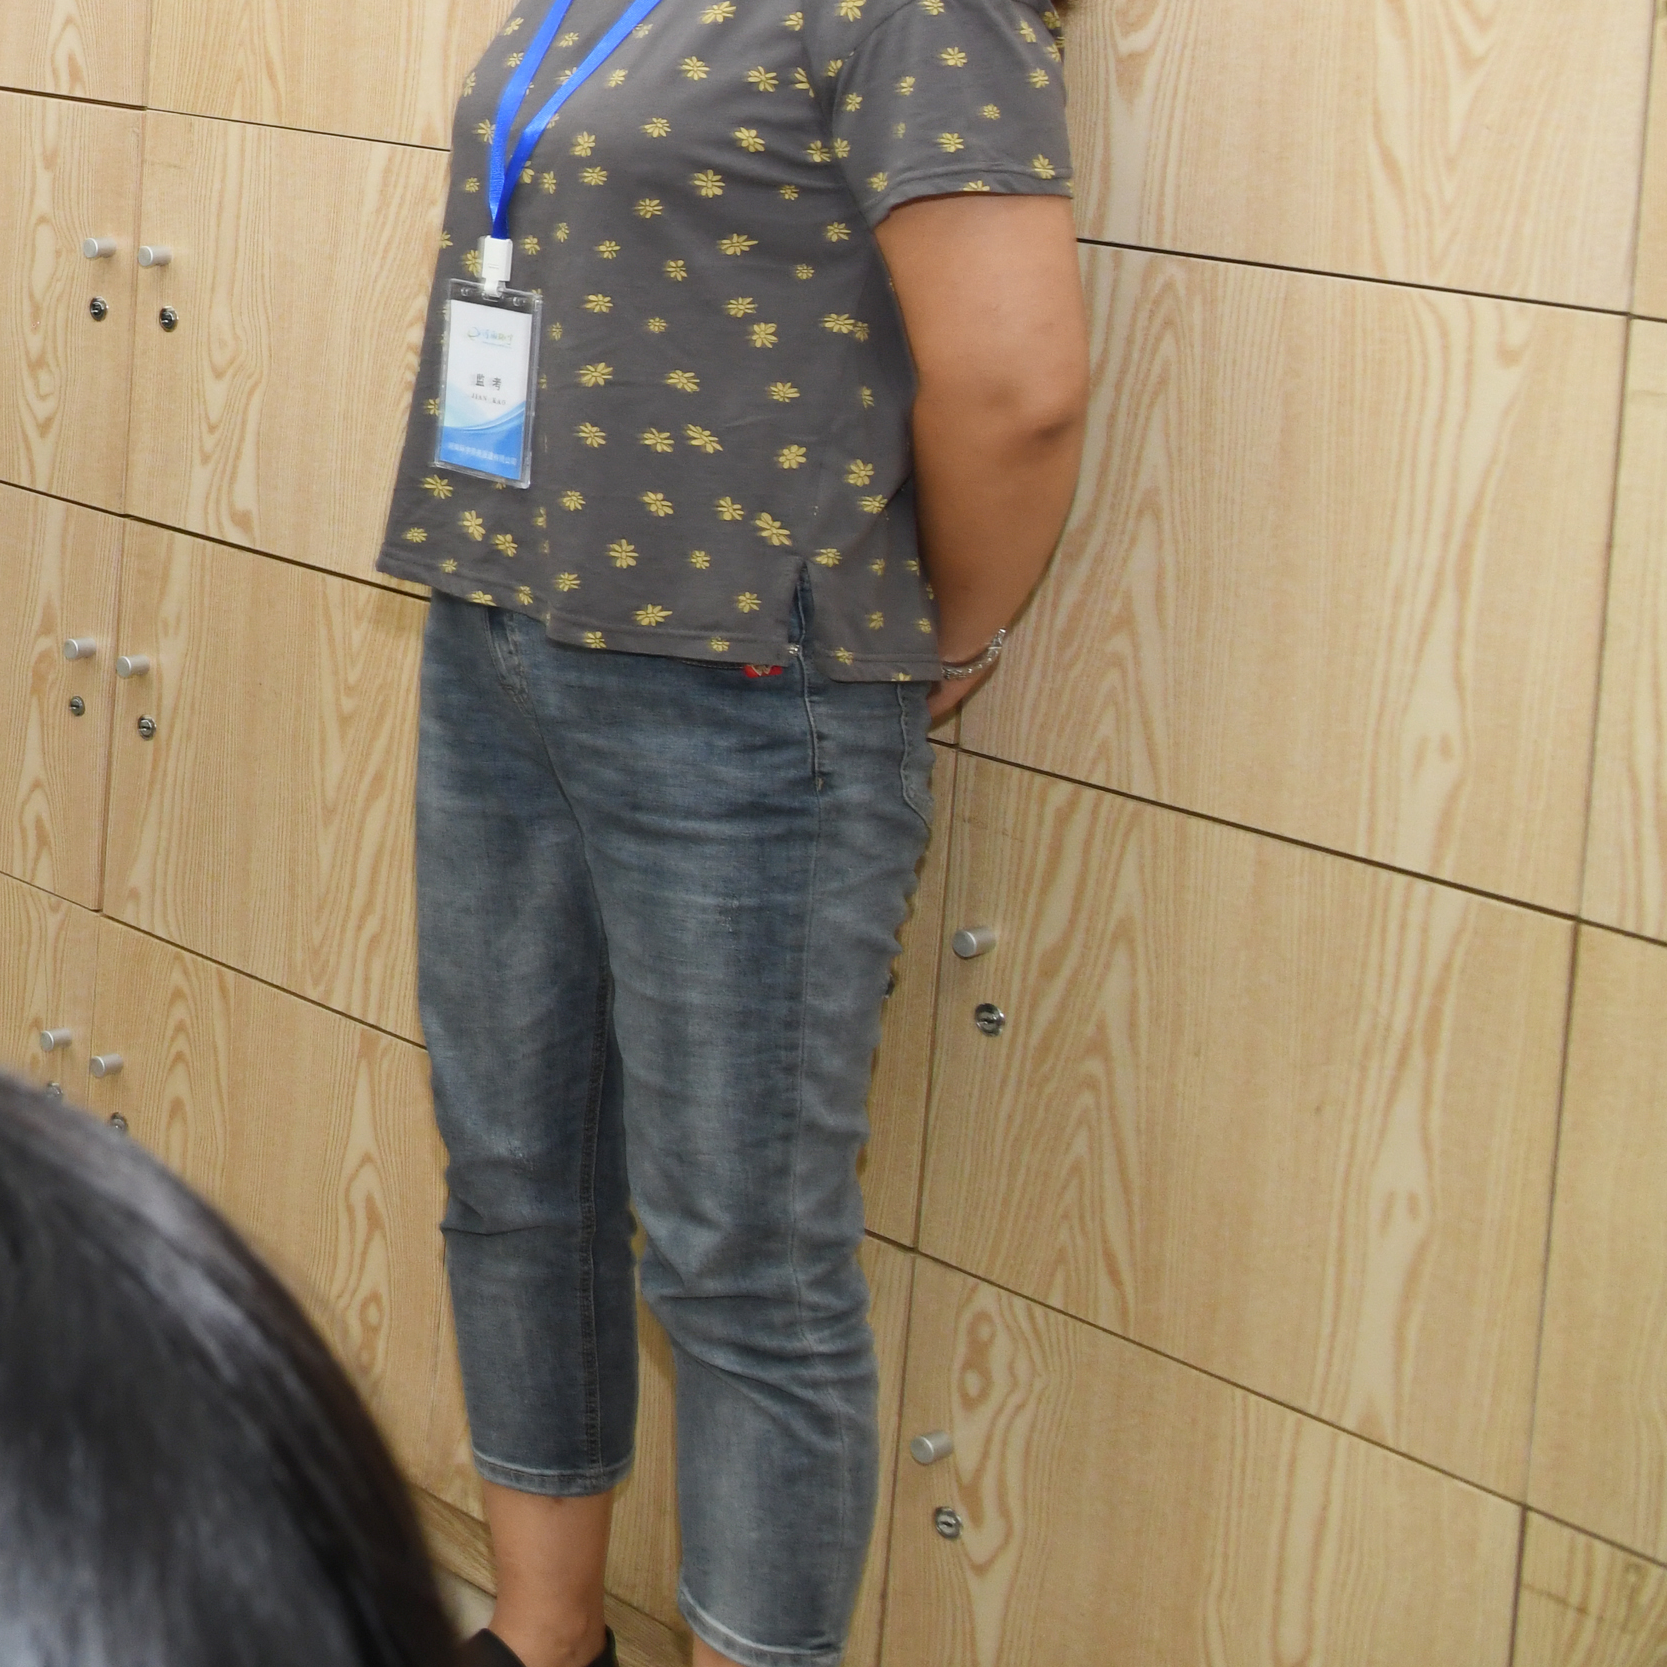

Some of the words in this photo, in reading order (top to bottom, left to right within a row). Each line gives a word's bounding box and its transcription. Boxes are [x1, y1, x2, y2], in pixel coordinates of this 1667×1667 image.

[475, 373, 502, 391] 监考
[471, 392, 487, 402] JIAN
[492, 397, 507, 406] KAO
